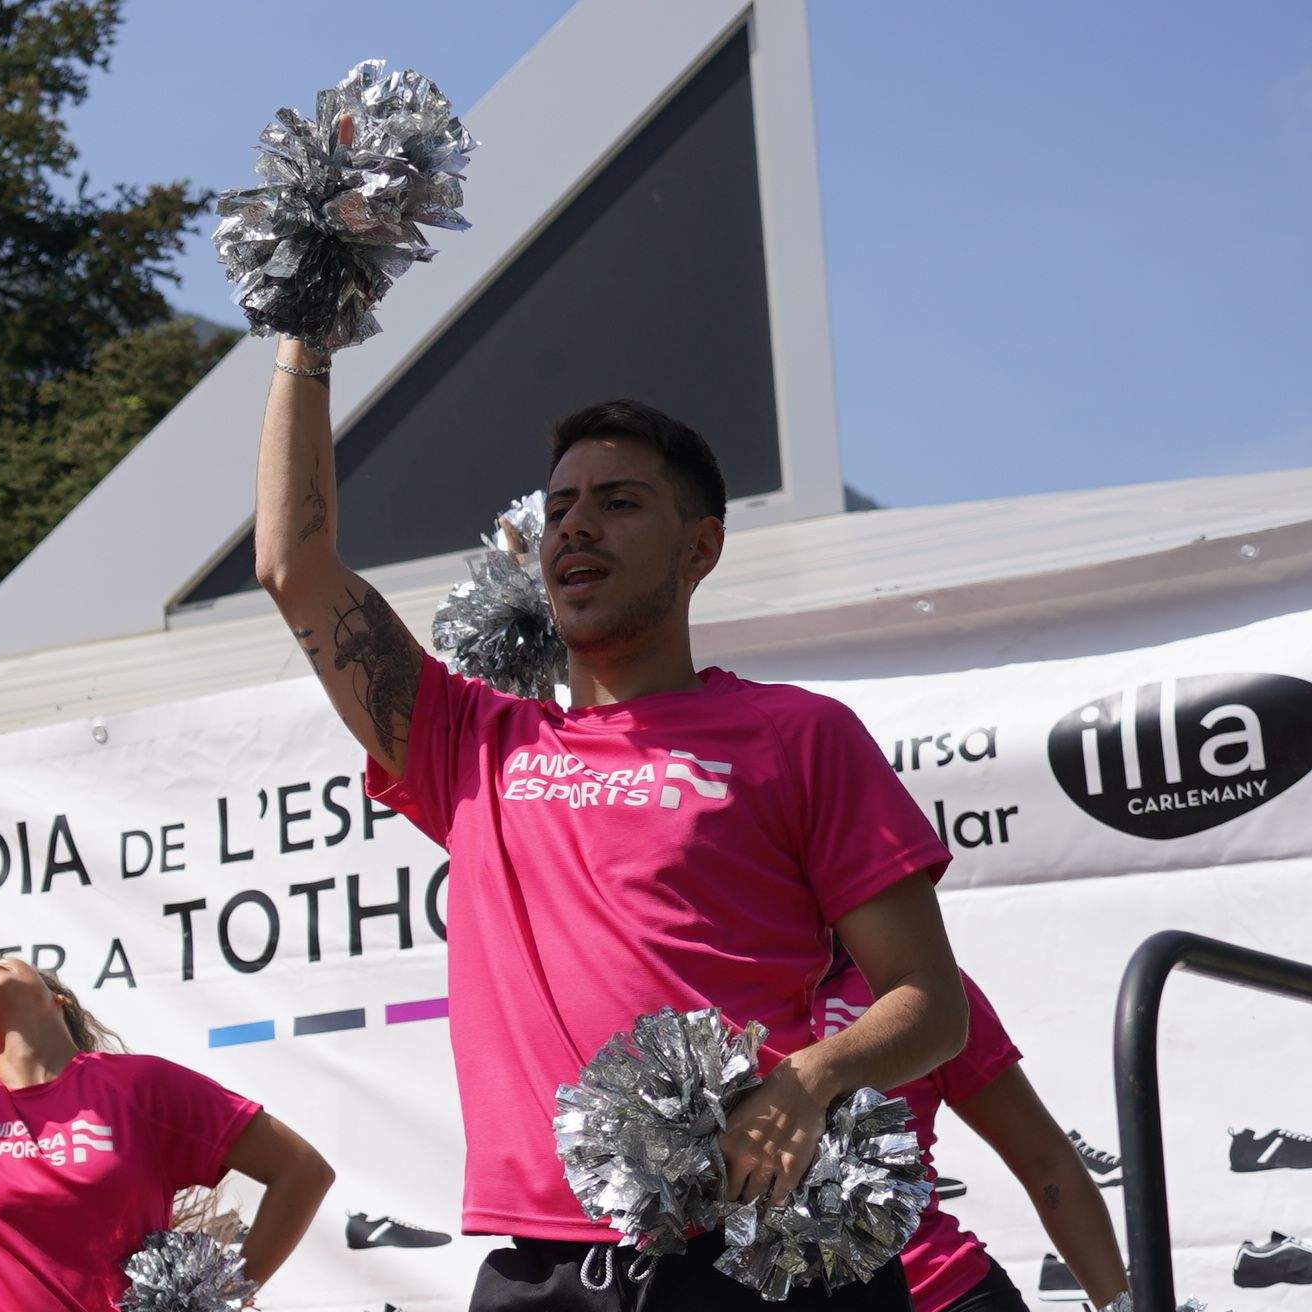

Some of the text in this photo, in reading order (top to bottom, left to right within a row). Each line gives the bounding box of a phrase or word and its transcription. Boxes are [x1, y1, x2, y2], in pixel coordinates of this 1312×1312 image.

[1080, 679, 1267, 796] illa
[503, 777, 651, 810] ESPORTS
[1127, 779, 1268, 816] CARLEMANY
[933, 799, 1019, 850] lar
[120, 822, 186, 880] DE
[93, 937, 138, 990] A
